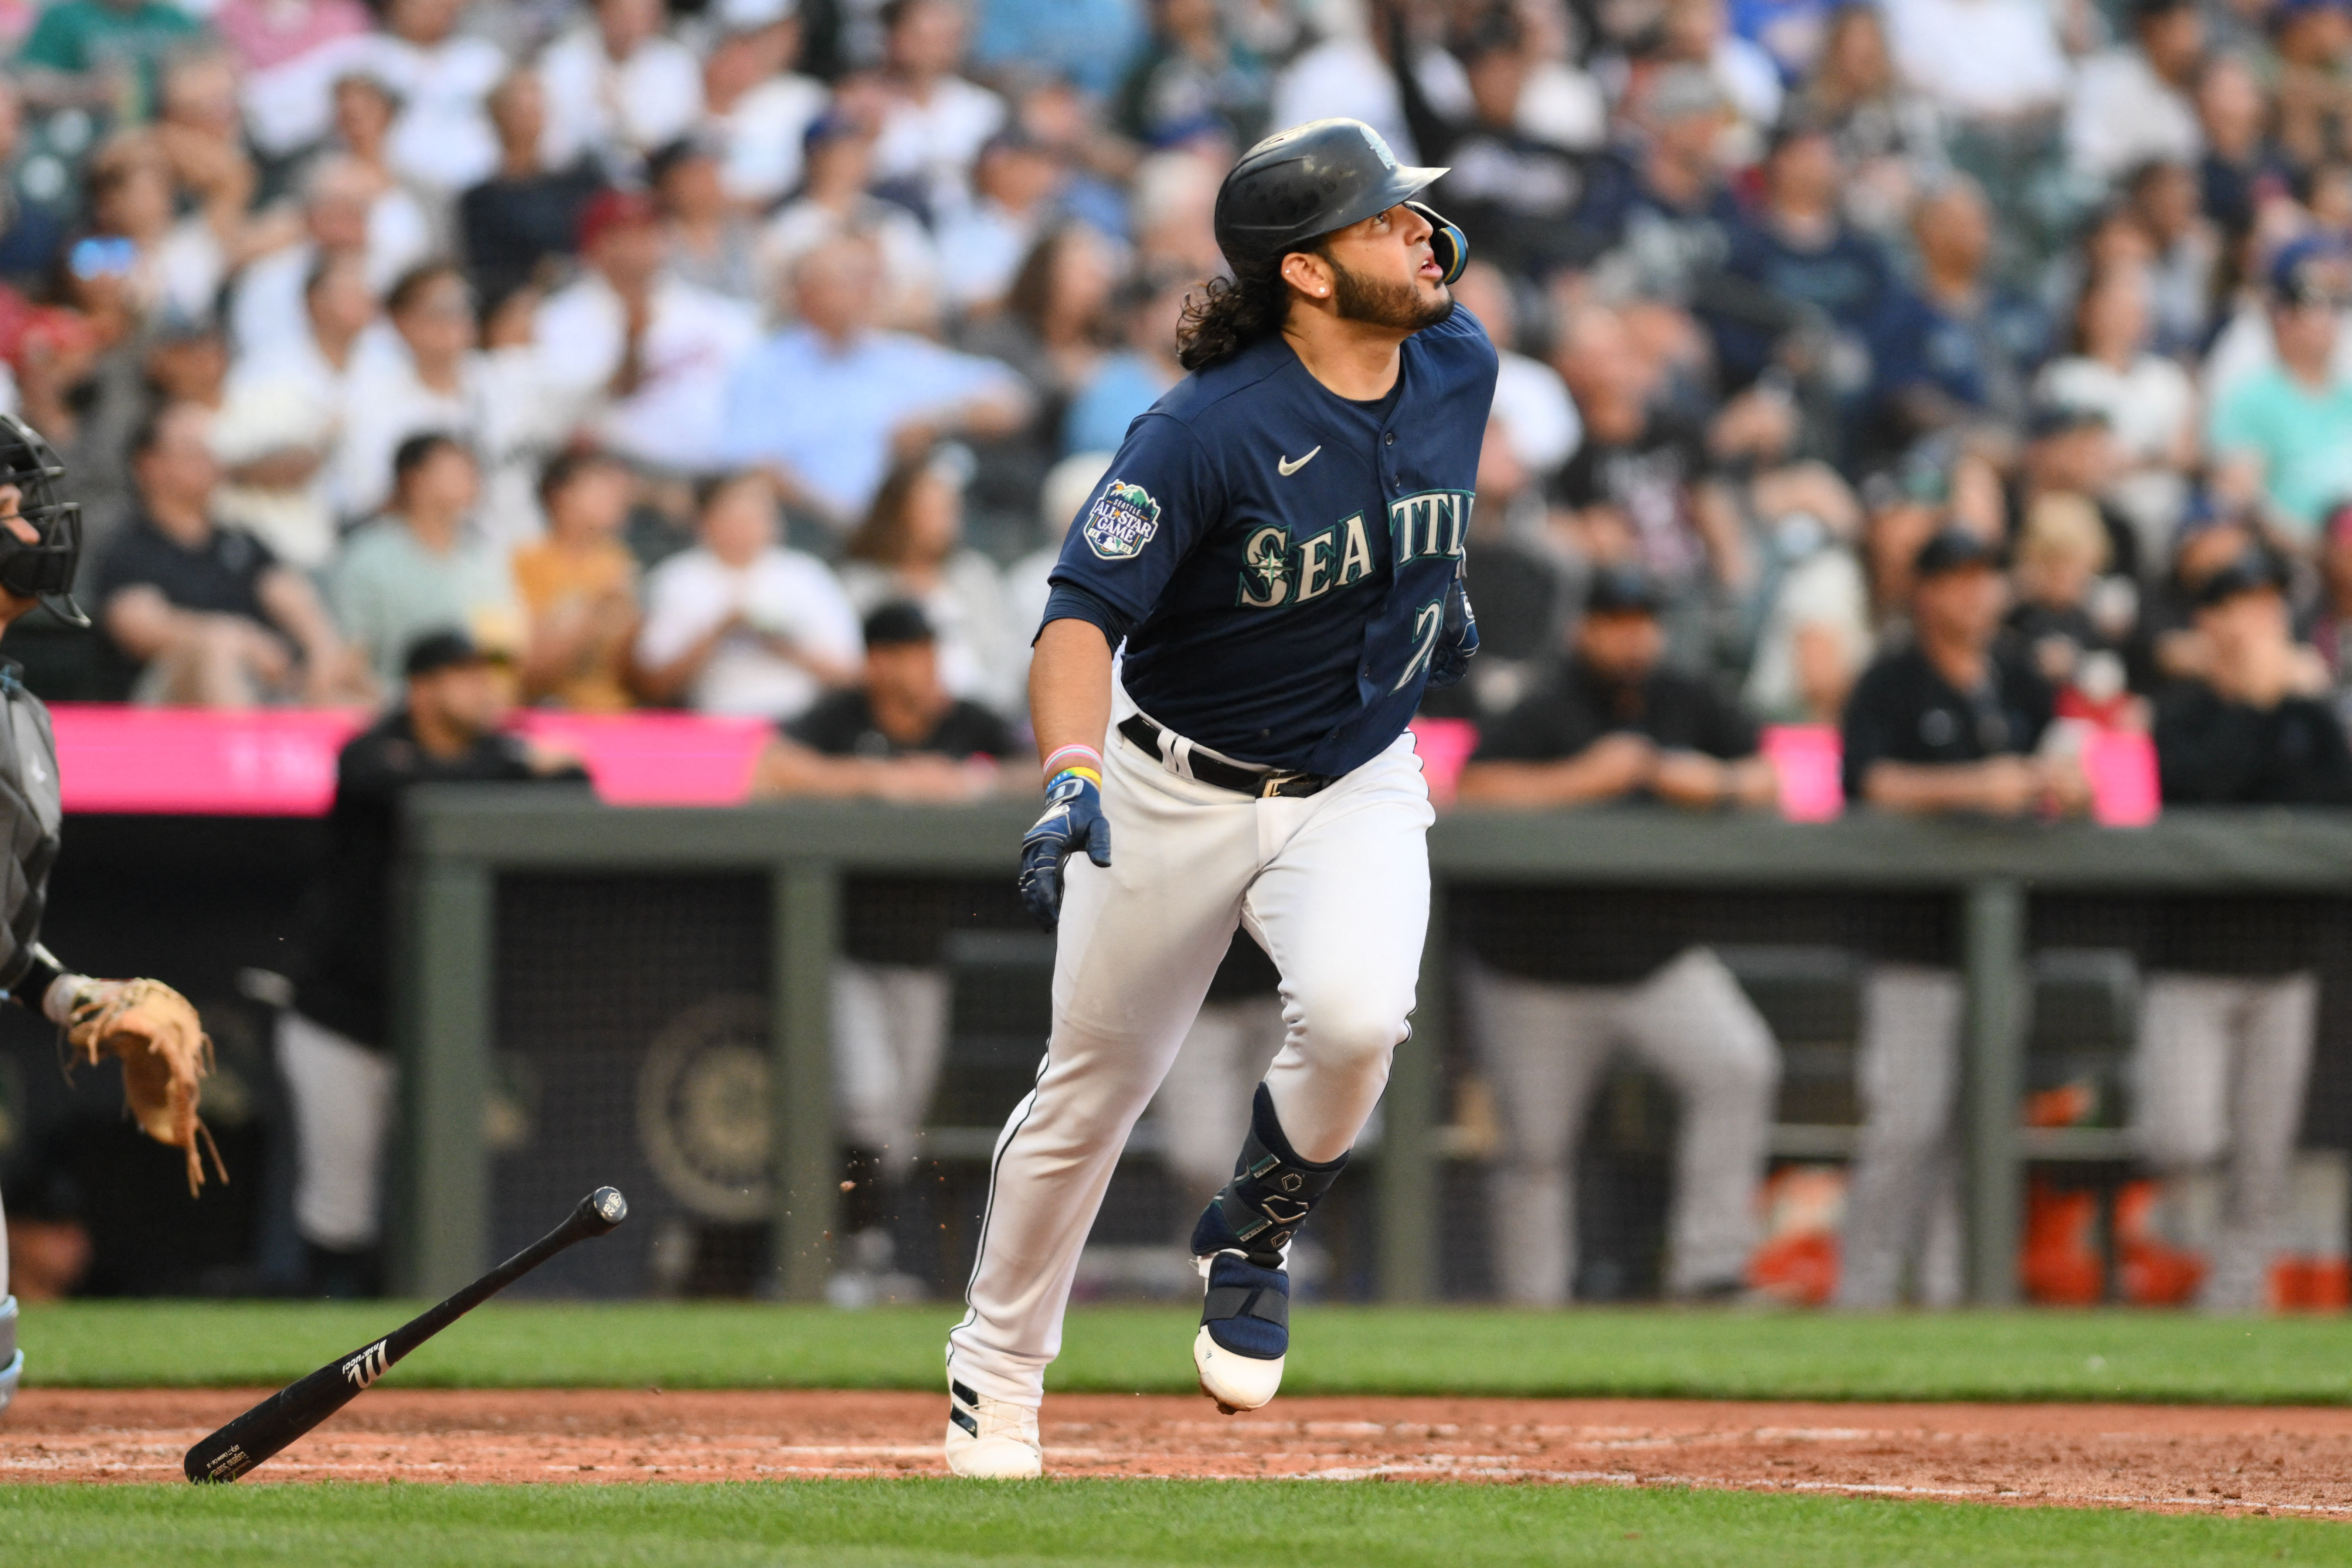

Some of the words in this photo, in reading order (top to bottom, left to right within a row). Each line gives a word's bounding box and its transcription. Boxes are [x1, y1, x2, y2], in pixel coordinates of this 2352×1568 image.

[1093, 501, 1116, 520] ALL
[1118, 511, 1152, 537] STAR
[1113, 499, 1141, 516] SEATTLE
[1097, 517, 1135, 543] GAME
[1236, 489, 1476, 608] SEATTL
[603, 1203, 615, 1217] 28
[342, 1343, 379, 1374] marucci
[227, 1451, 249, 1466] Eugenio
